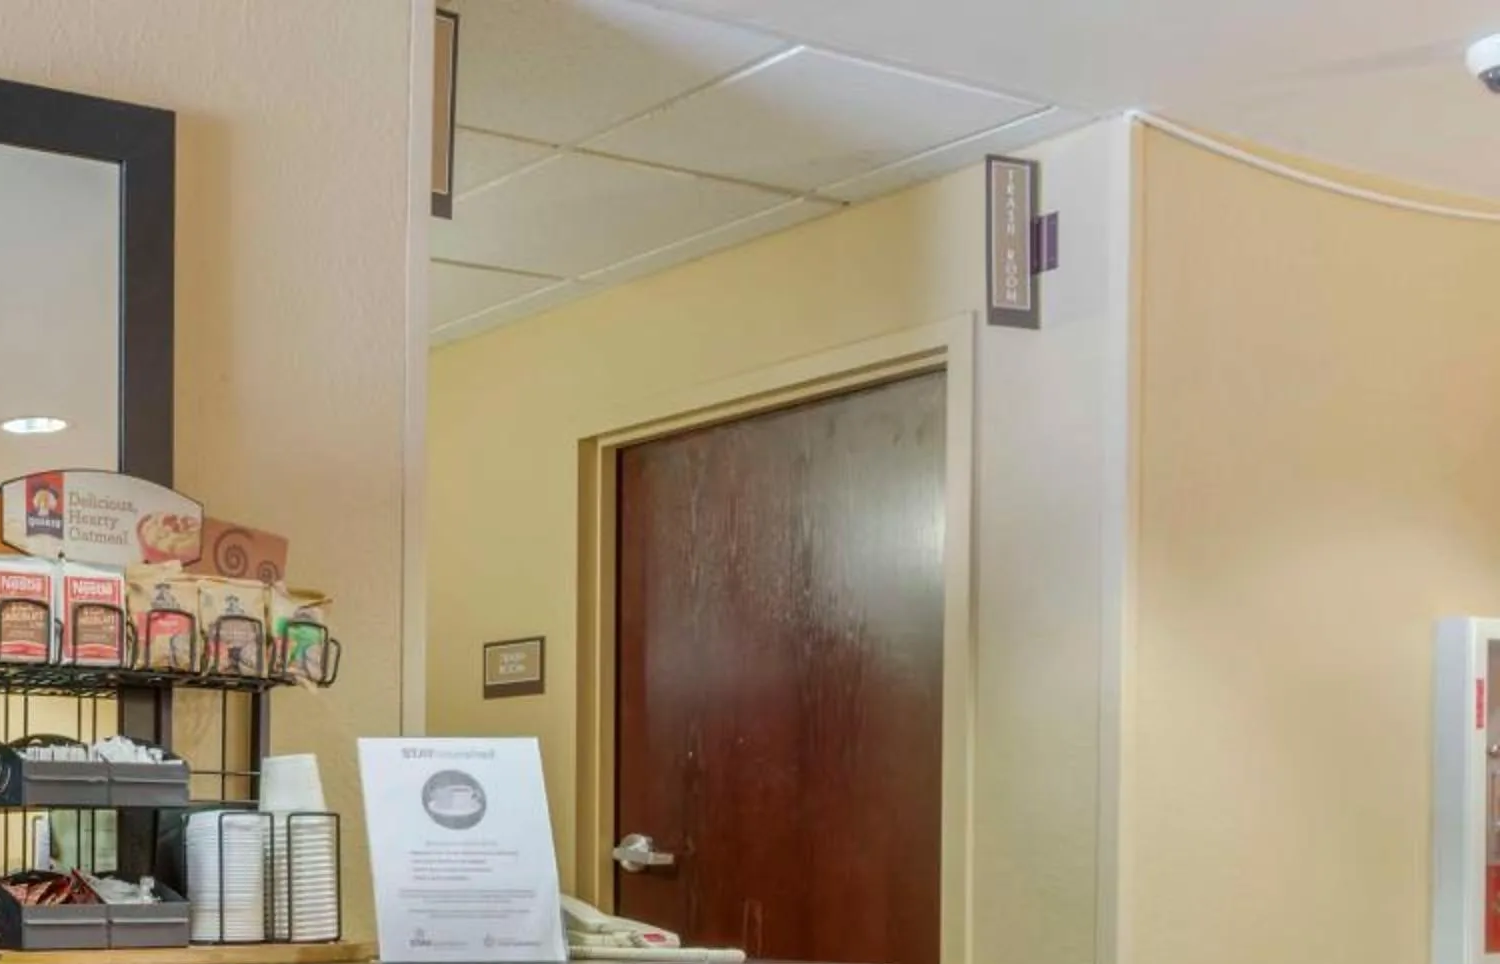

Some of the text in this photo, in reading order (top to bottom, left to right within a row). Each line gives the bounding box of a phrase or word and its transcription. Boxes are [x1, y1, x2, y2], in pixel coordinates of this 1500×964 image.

[1004, 168, 1018, 303] TRASH ROOM
[68, 491, 138, 513] Delicious,
[68, 510, 120, 529] Hearty
[69, 528, 131, 546] Oatmeal
